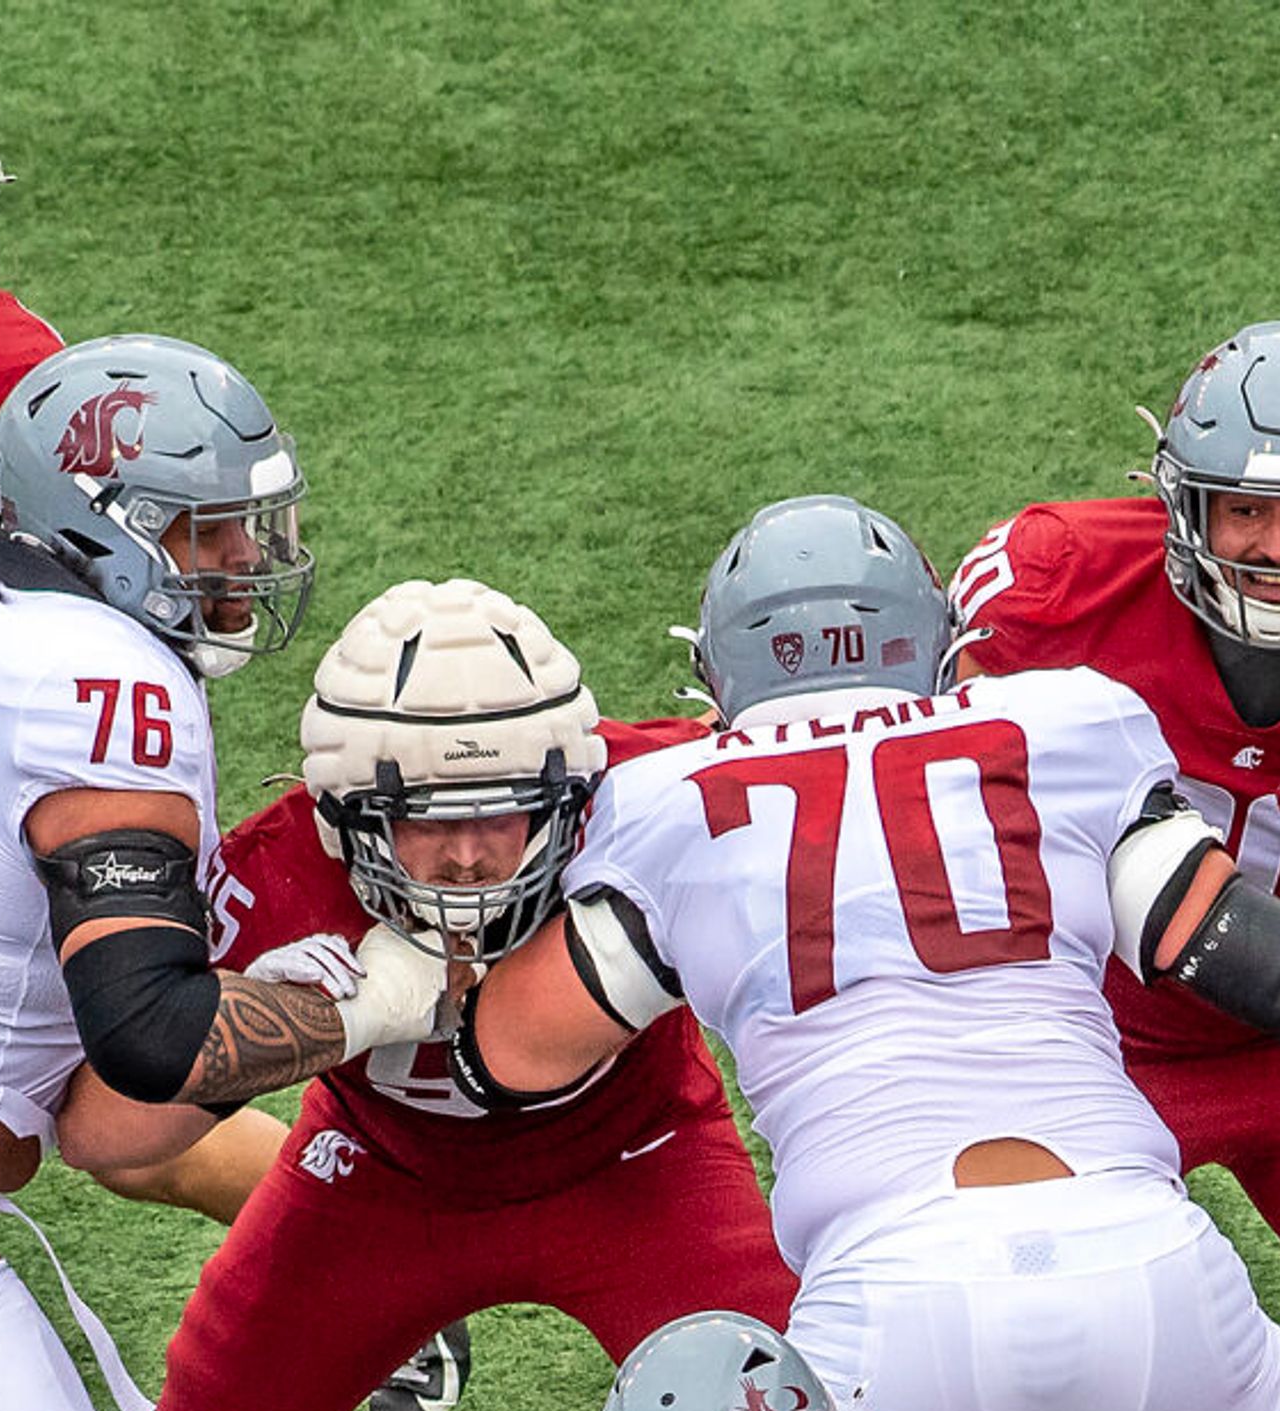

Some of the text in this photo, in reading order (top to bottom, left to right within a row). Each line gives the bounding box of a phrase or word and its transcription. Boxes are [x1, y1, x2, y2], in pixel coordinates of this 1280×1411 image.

[822, 624, 865, 667] 70
[74, 678, 172, 768] 76
[681, 717, 1054, 1017] 70
